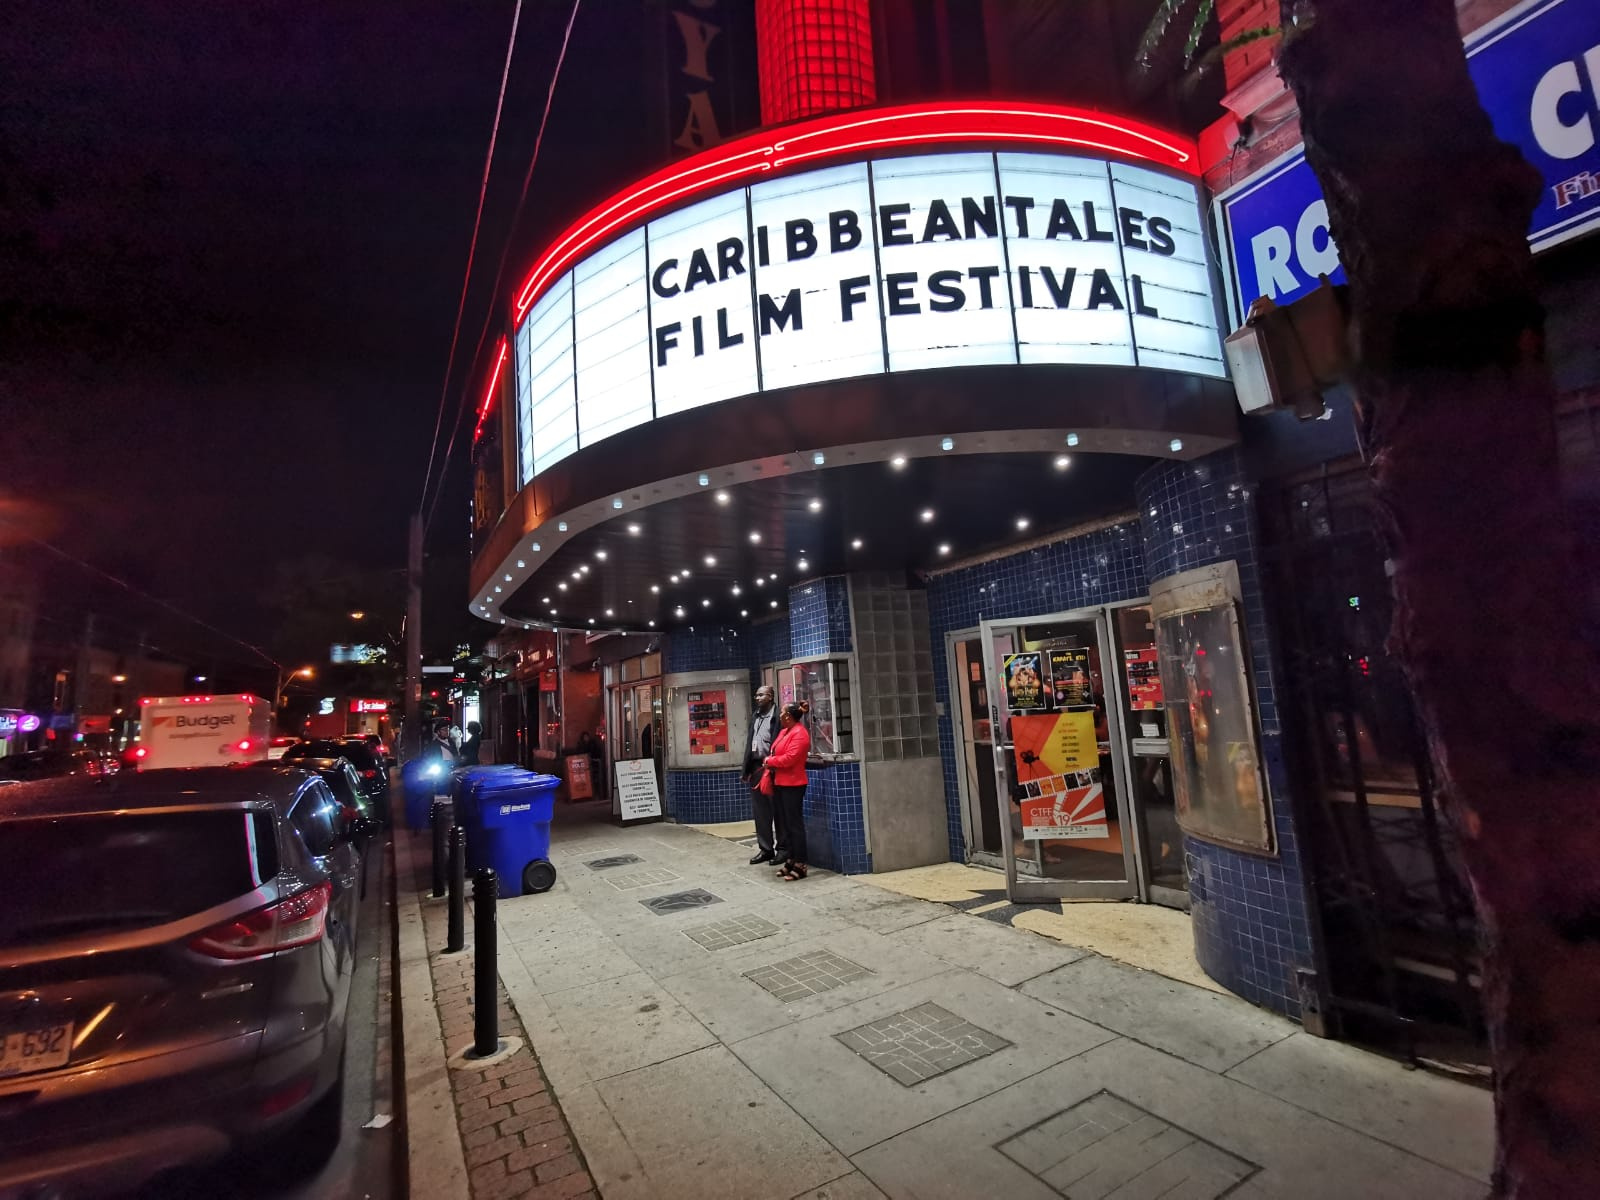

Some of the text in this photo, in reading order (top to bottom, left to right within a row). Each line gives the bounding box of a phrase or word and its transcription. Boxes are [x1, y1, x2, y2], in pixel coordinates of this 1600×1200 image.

[652, 195, 1176, 298] CARIBBEANTALES
[655, 265, 1159, 367] FILM FESTIVAL
[175, 714, 236, 730] Budget
[1030, 807, 1053, 817] CTFF
[22, 1026, 67, 1058] 692
